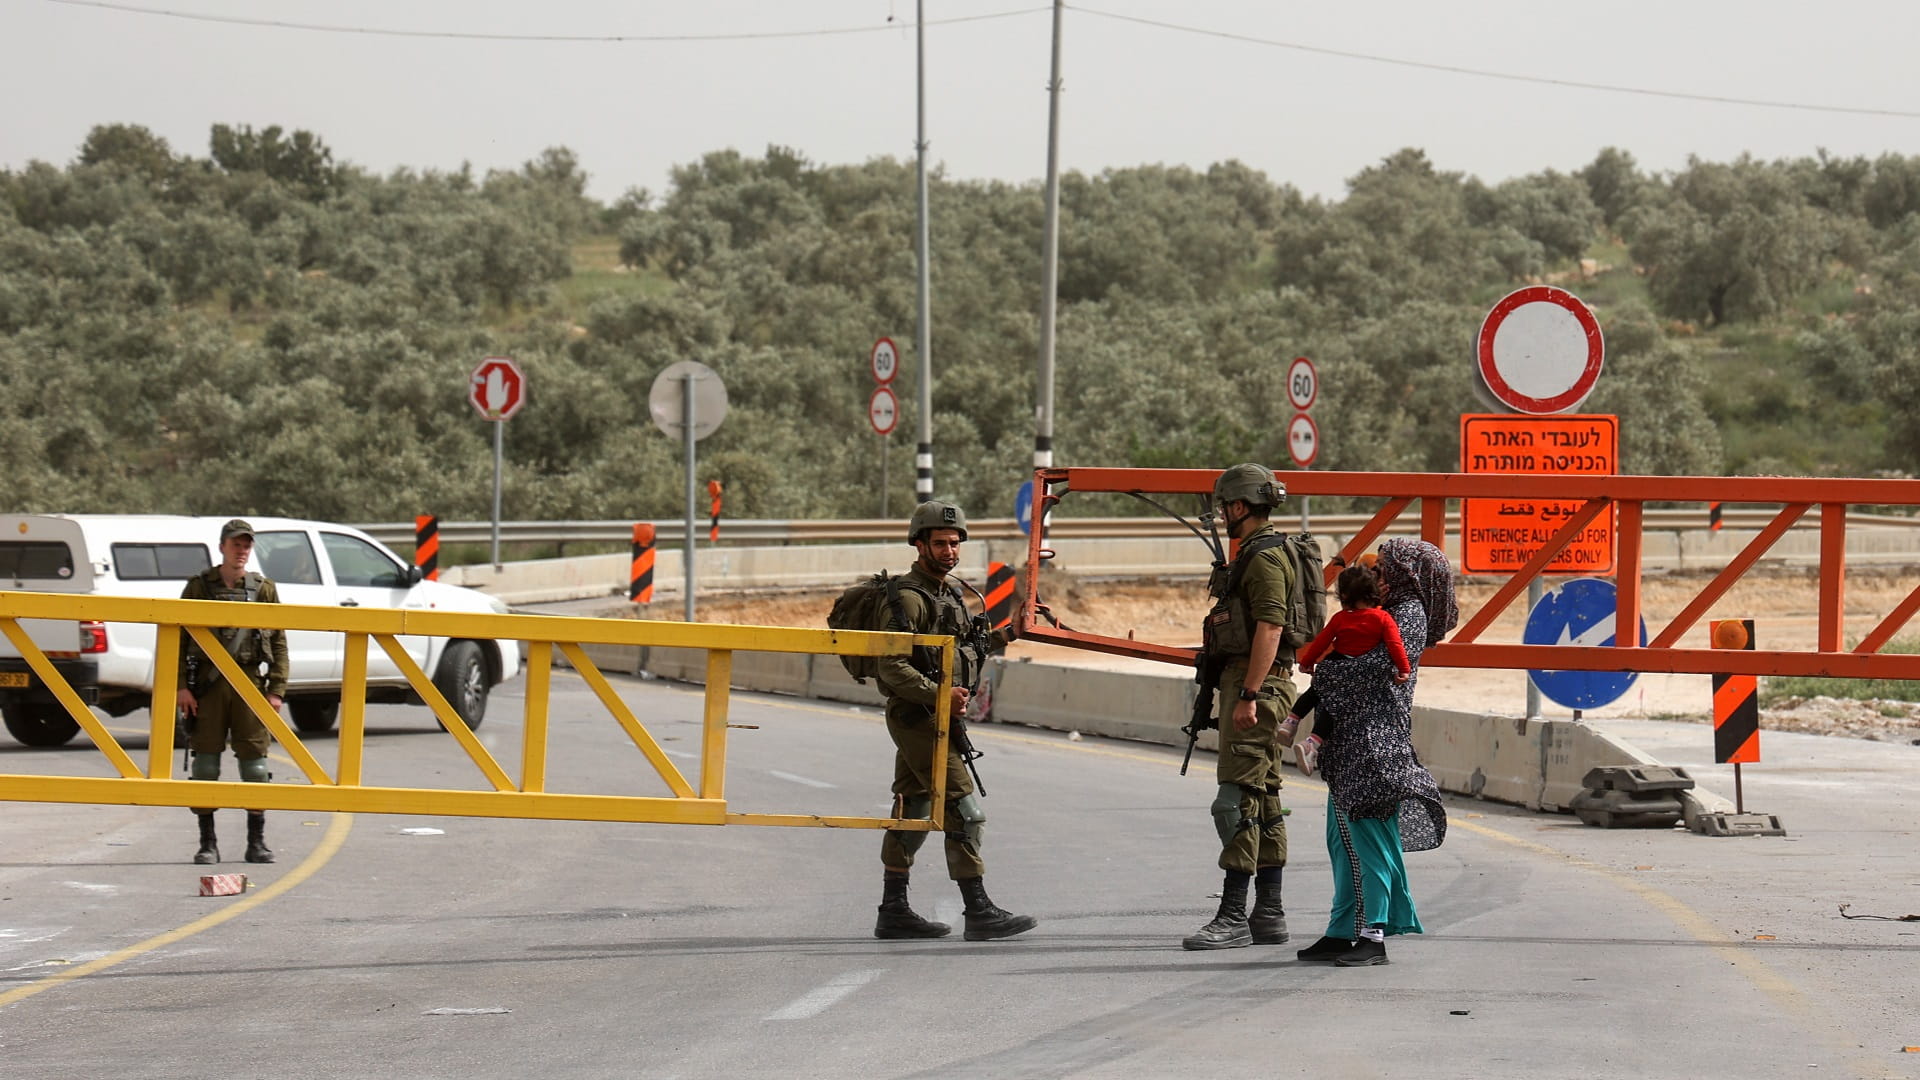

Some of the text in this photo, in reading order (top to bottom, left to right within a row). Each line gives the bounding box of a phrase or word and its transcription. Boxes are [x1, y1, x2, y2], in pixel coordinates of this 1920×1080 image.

[876, 352, 891, 371] 60
[1293, 374, 1311, 398] 60
[1481, 427, 1600, 448] לעובדי האתר
[1473, 455, 1607, 470] הכניסה מותרת
[1498, 503, 1534, 516] فقط
[1470, 528, 1528, 543] ENTRENCE
[1587, 529, 1607, 543] FOR
[1490, 548, 1513, 564] SITE
[1575, 549, 1602, 564] ONLY
